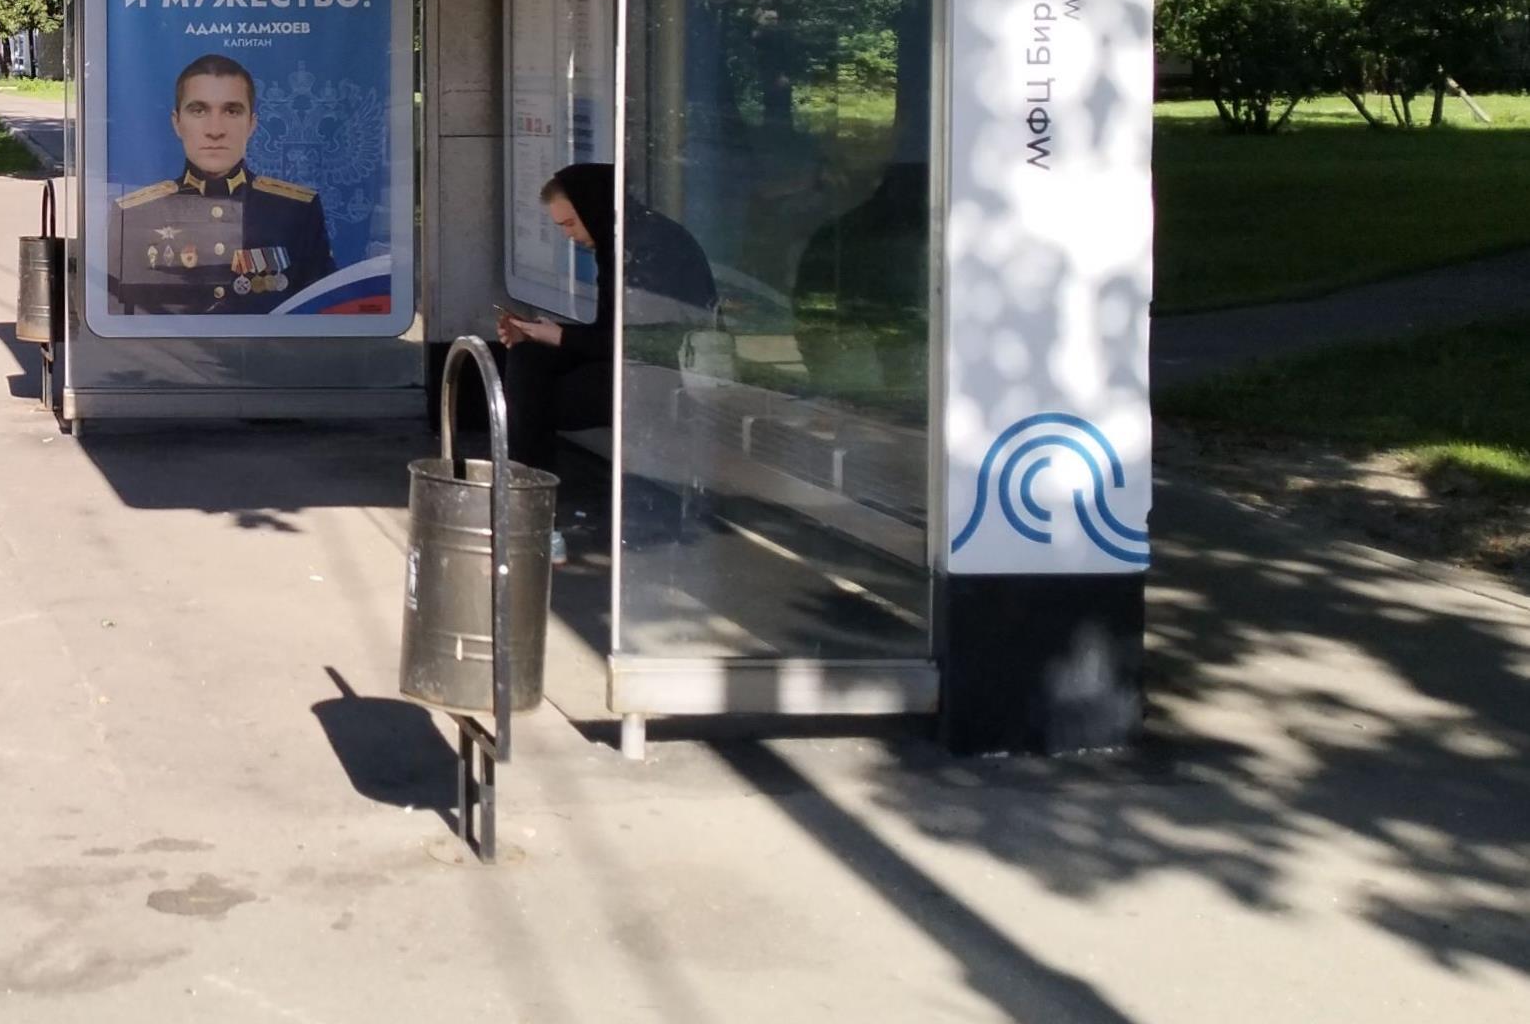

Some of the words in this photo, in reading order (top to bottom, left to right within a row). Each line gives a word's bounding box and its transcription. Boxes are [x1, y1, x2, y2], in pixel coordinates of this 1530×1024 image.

[184, 22, 232, 35] АДАМ
[237, 22, 311, 34] ХАМХОЕВ
[223, 39, 272, 47] КАПИТАН
[1026, 77, 1056, 170] МФЦ
